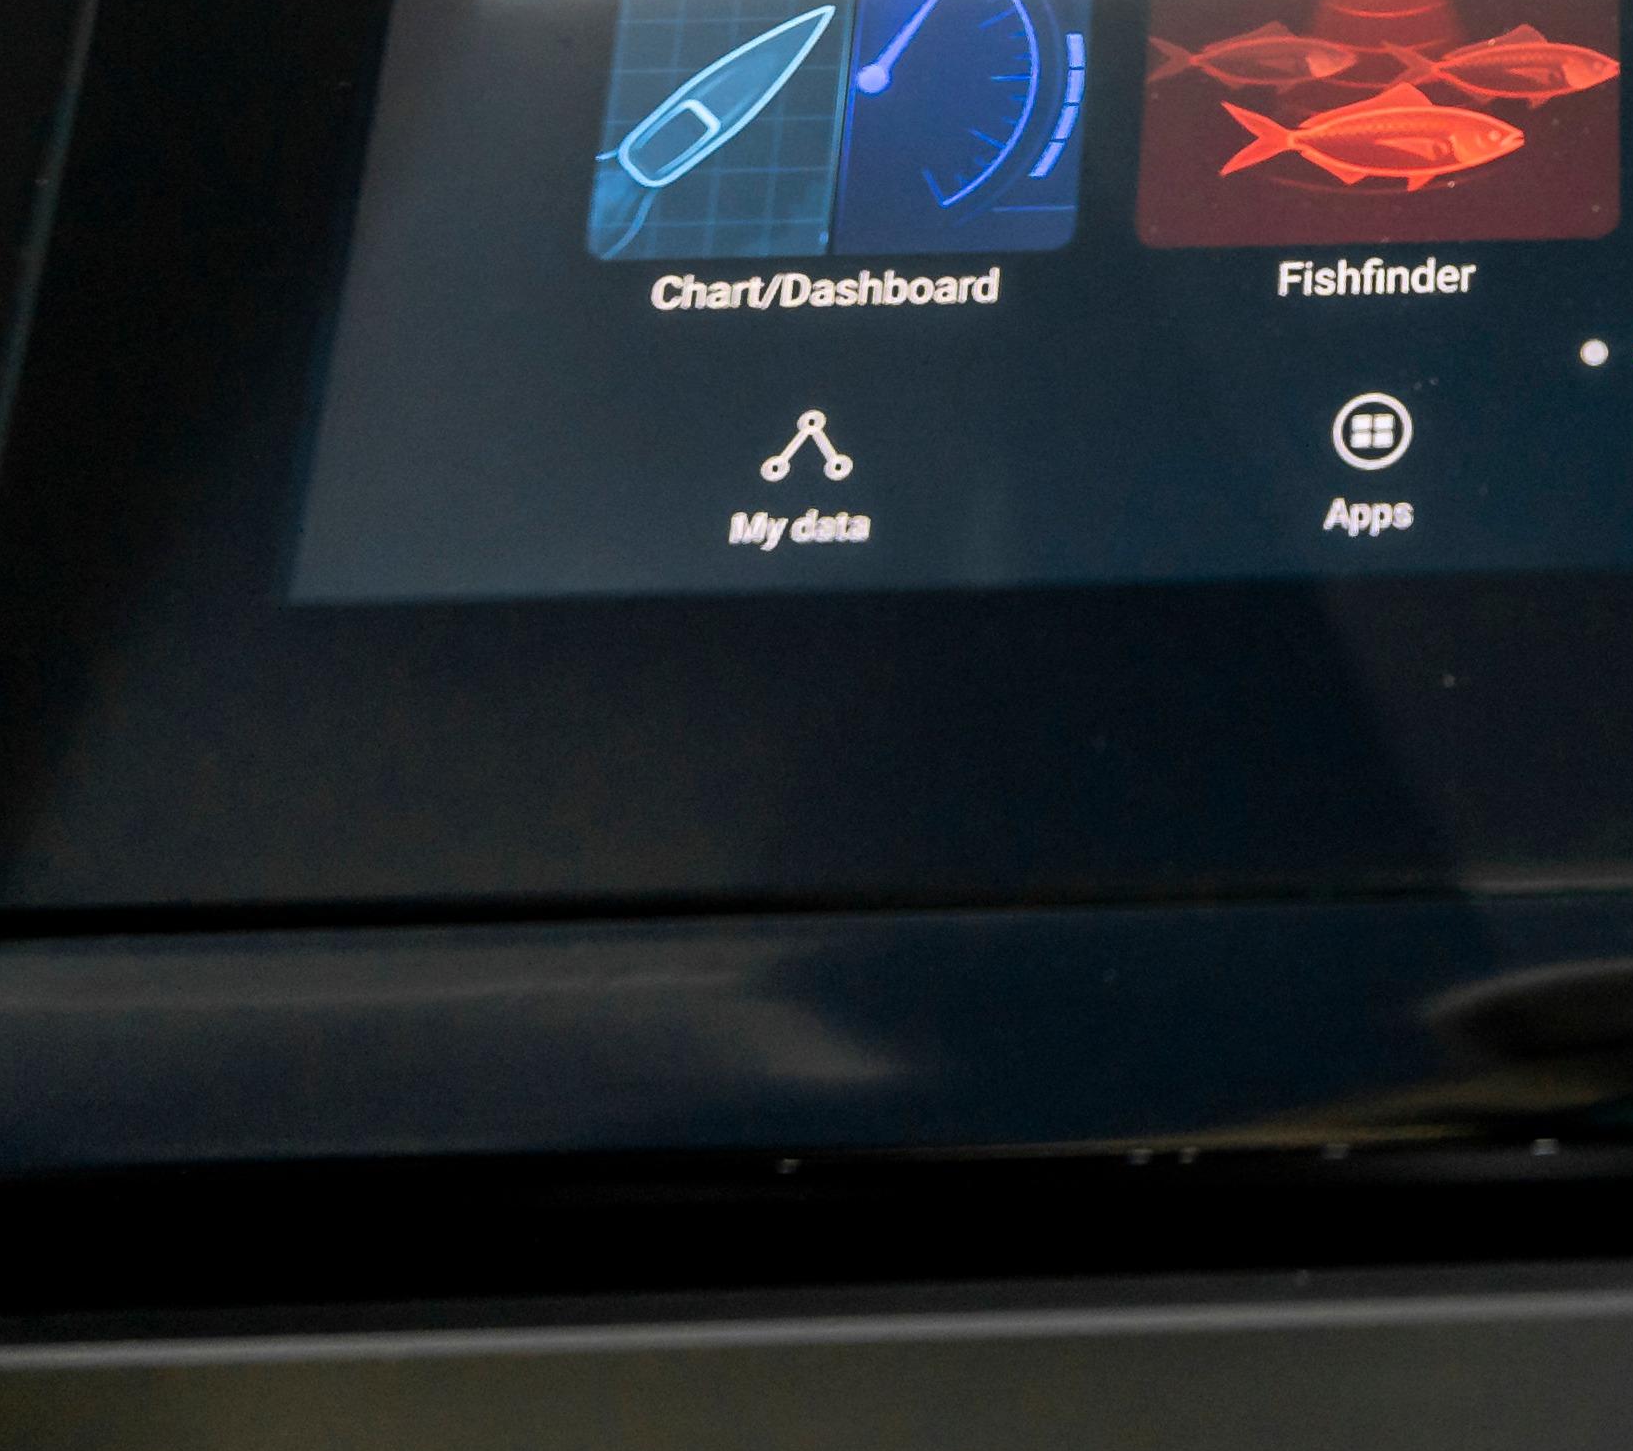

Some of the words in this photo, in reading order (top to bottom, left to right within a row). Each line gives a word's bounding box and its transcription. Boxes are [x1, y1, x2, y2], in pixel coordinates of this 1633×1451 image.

[650, 266, 1001, 311] Chart/Dashboard
[1277, 256, 1477, 297] Fishfinder
[728, 511, 789, 552] My
[791, 508, 872, 544] data
[1322, 497, 1414, 538] Apps
